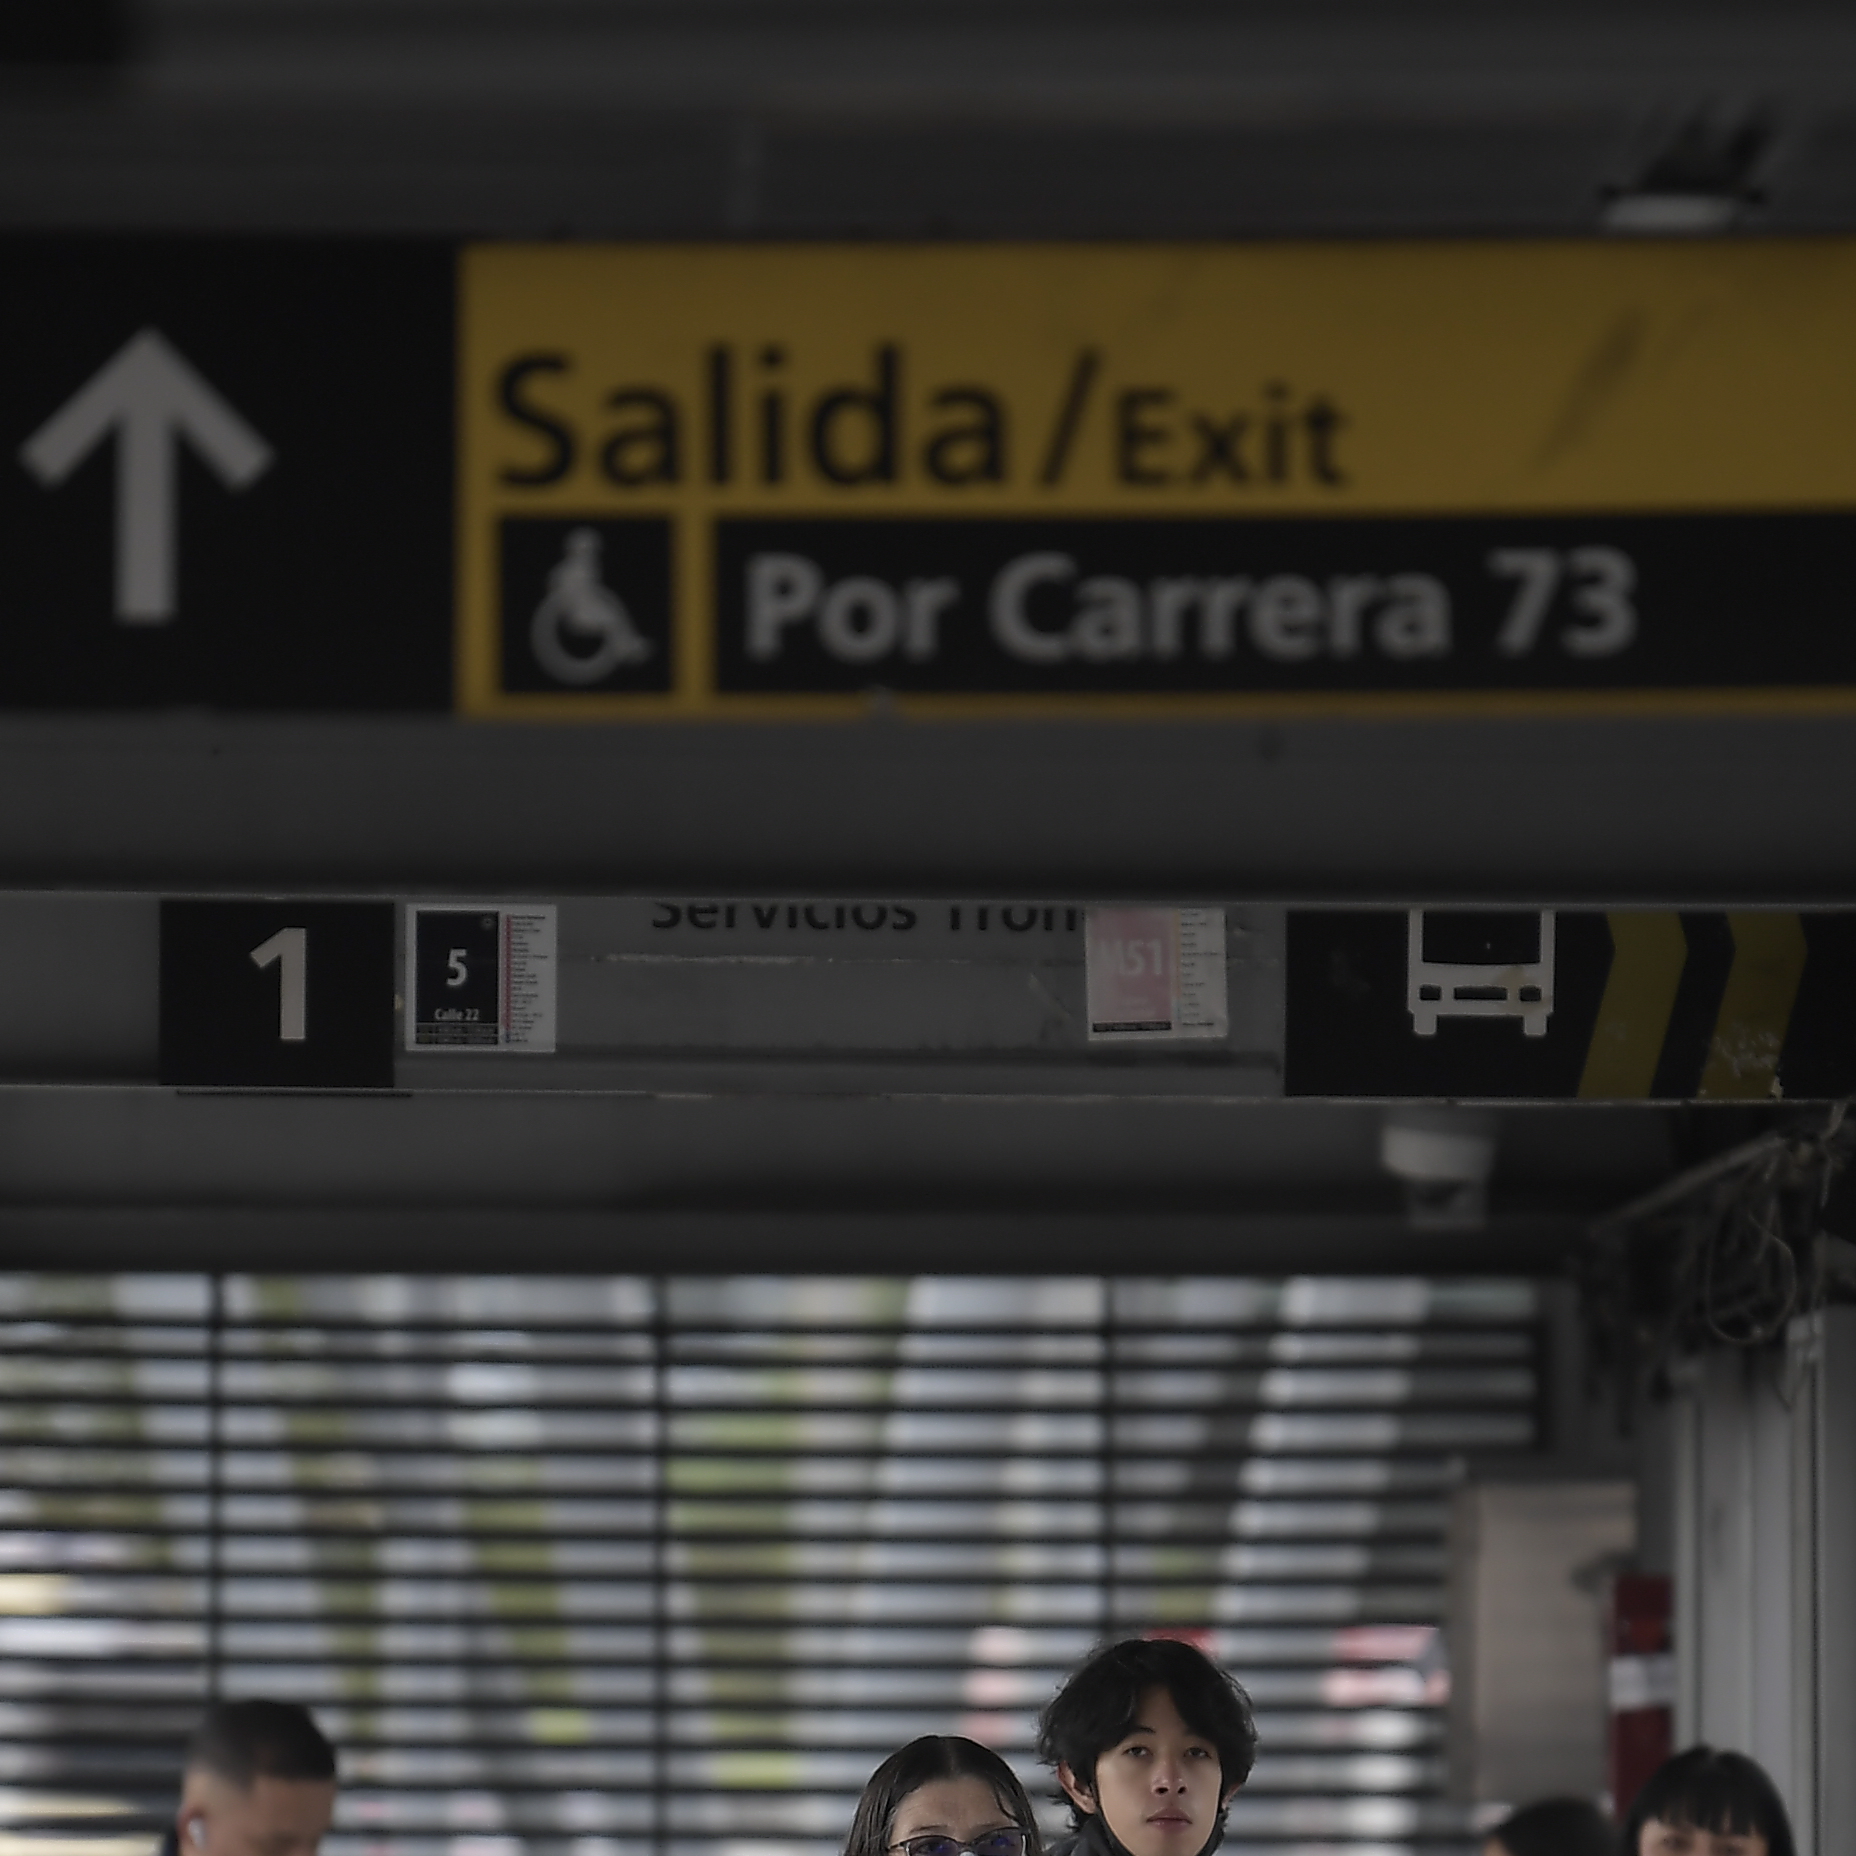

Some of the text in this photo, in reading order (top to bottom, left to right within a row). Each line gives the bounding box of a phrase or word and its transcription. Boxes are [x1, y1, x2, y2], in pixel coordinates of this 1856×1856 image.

[746, 546, 1637, 663] Por Carrera 73
[249, 927, 307, 1041] 1
[446, 948, 468, 987] 5
[434, 1007, 480, 1021] Calle 22
